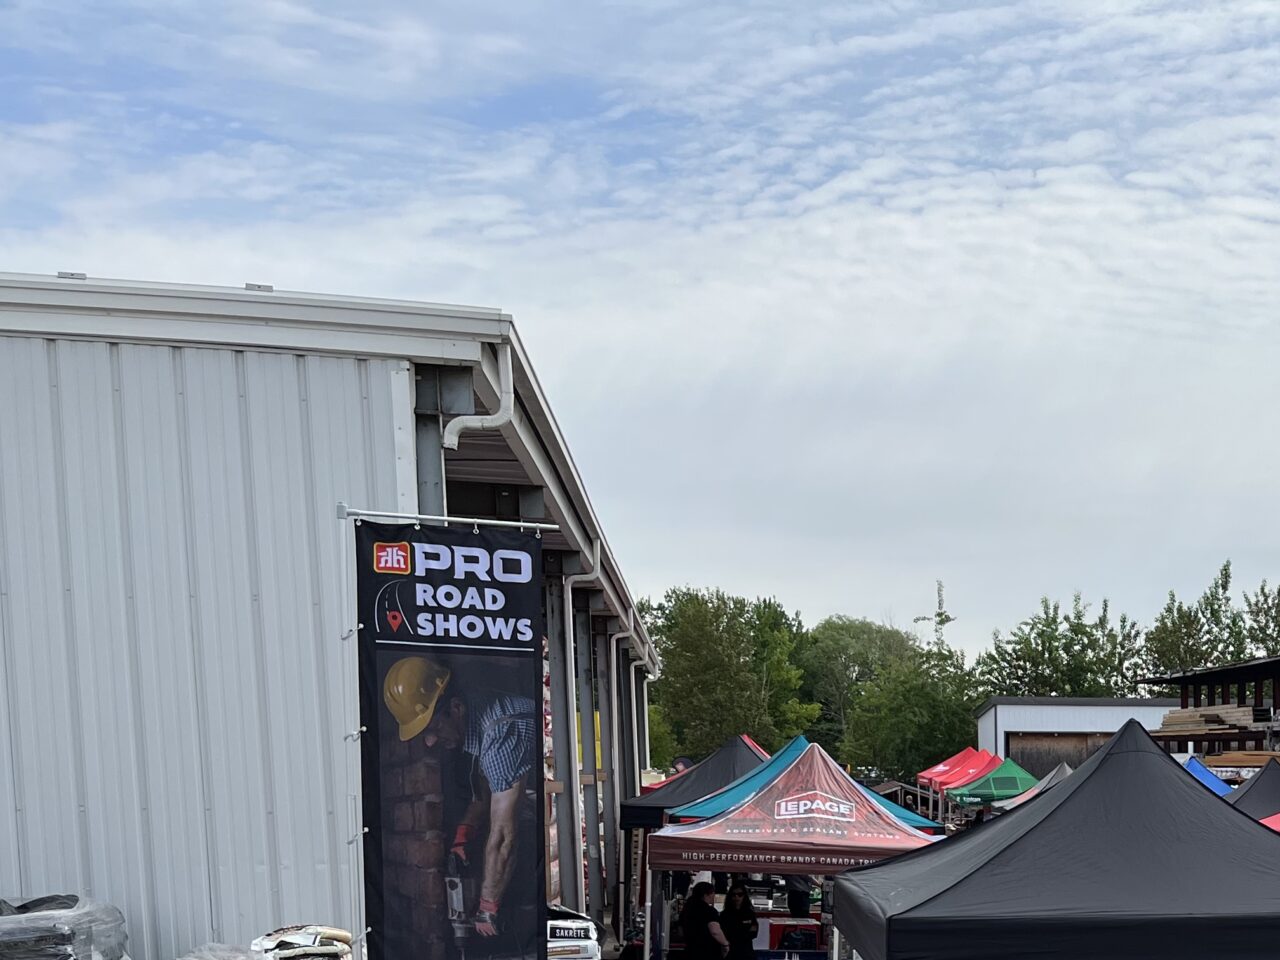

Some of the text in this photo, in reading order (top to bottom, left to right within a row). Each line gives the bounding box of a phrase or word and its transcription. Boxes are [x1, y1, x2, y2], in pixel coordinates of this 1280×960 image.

[412, 542, 533, 583] PRO
[415, 583, 506, 611] ROAD
[416, 613, 533, 641] SHOWS
[682, 851, 777, 863] HIGH-PERFORMANCE
[780, 855, 816, 865] BRANDS
[820, 856, 856, 866] CANADA
[556, 929, 585, 938] SAKRETE
